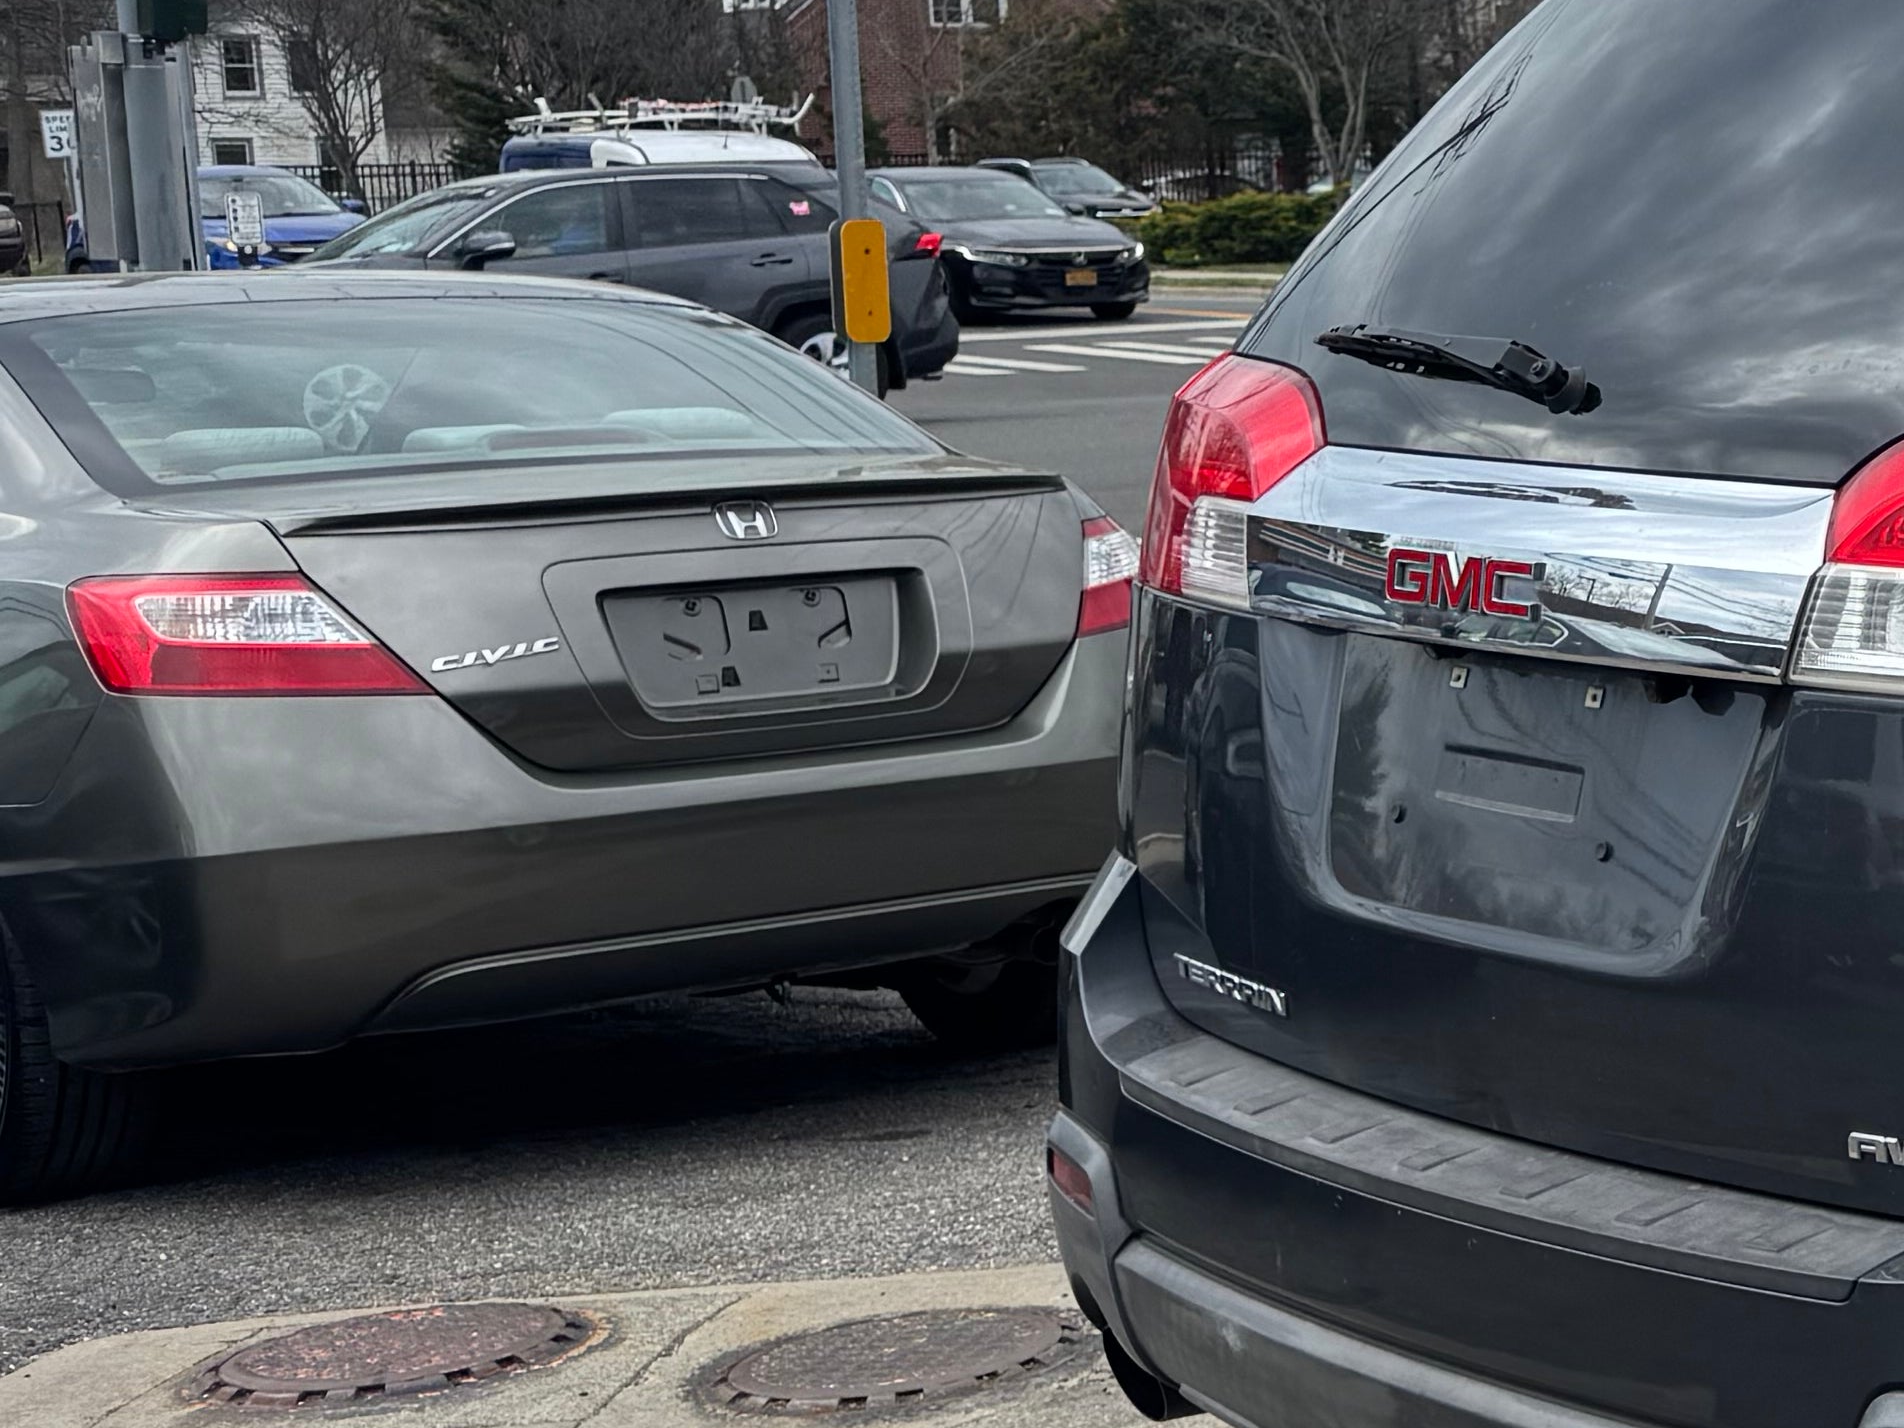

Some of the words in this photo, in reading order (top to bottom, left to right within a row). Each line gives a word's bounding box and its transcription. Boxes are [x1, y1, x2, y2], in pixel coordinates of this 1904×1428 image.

[1384, 547, 1547, 623] GMC
[431, 636, 560, 672] CIVIC
[1173, 952, 1287, 1017] TERRAIN
